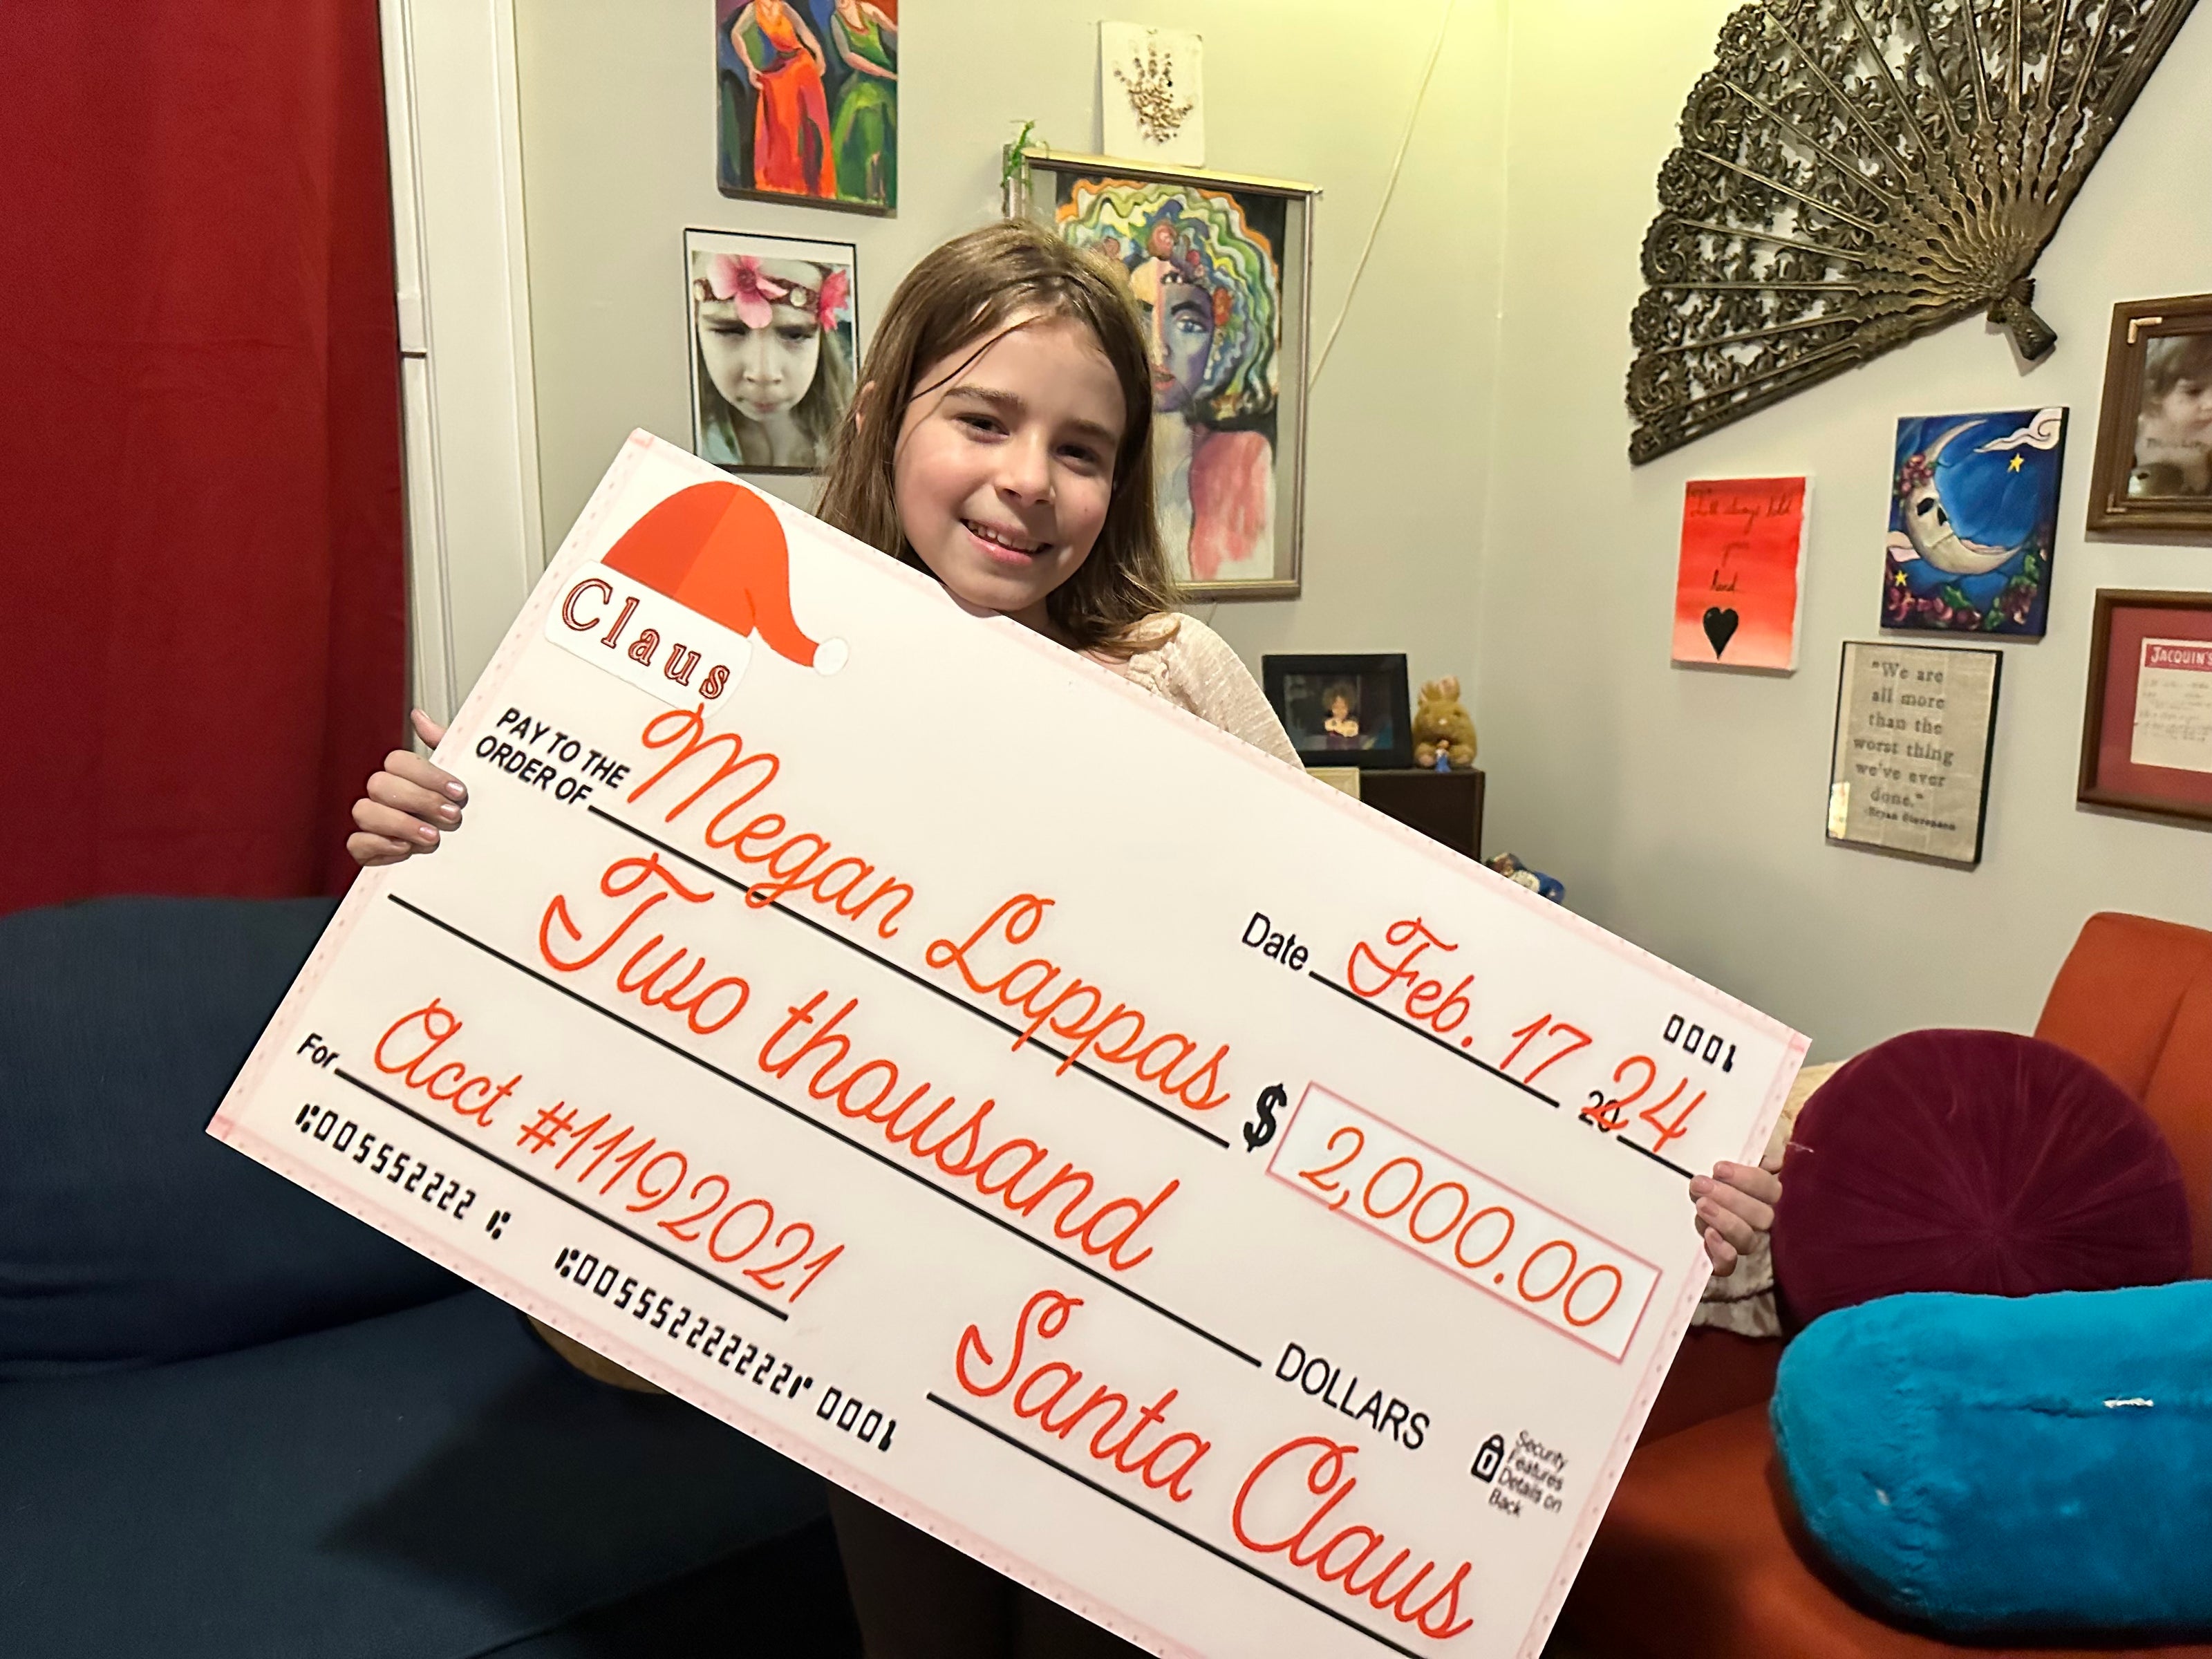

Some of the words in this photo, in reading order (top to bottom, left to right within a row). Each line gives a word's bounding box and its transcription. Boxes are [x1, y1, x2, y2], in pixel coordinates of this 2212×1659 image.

[561, 578, 730, 700] Claus
[1871, 688, 1893, 704] all
[1901, 693, 1945, 710] more
[1917, 669, 1944, 683] are
[496, 706, 552, 746] PAY
[546, 731, 582, 764] TO
[579, 748, 630, 790] THE
[1853, 738, 1898, 755] worst
[1906, 742, 1954, 767] thing
[1868, 711, 1906, 731] than
[1914, 716, 1942, 735] the
[475, 735, 556, 792] ORDER
[554, 776, 593, 807] OF
[1855, 761, 1901, 781] we've
[1909, 771, 1947, 788] ever
[627, 702, 914, 939] Megan
[925, 892, 1231, 1112] Lappas
[1241, 911, 1310, 971] Date
[1347, 917, 1474, 1049] Feb.
[1499, 1013, 1593, 1084] 17
[539, 852, 749, 1035] Two
[758, 991, 1180, 1271] thousand
[1662, 1013, 1737, 1074] 0001
[1580, 1054, 1707, 1153] 24
[296, 1033, 339, 1069] For
[374, 997, 523, 1127] Acct
[516, 1100, 845, 1304] #11192021
[1244, 1082, 1288, 1153] $
[1299, 1127, 1622, 1327] 2,000.00
[816, 1385, 897, 1452] 0001
[1275, 1342, 1432, 1453] DOLLARS
[955, 1289, 1212, 1503] Santa
[1232, 1435, 1474, 1641] Claus
[1516, 1429, 1569, 1473] Security
[1488, 1487, 1521, 1517] Back
[1542, 1494, 1564, 1513] on
